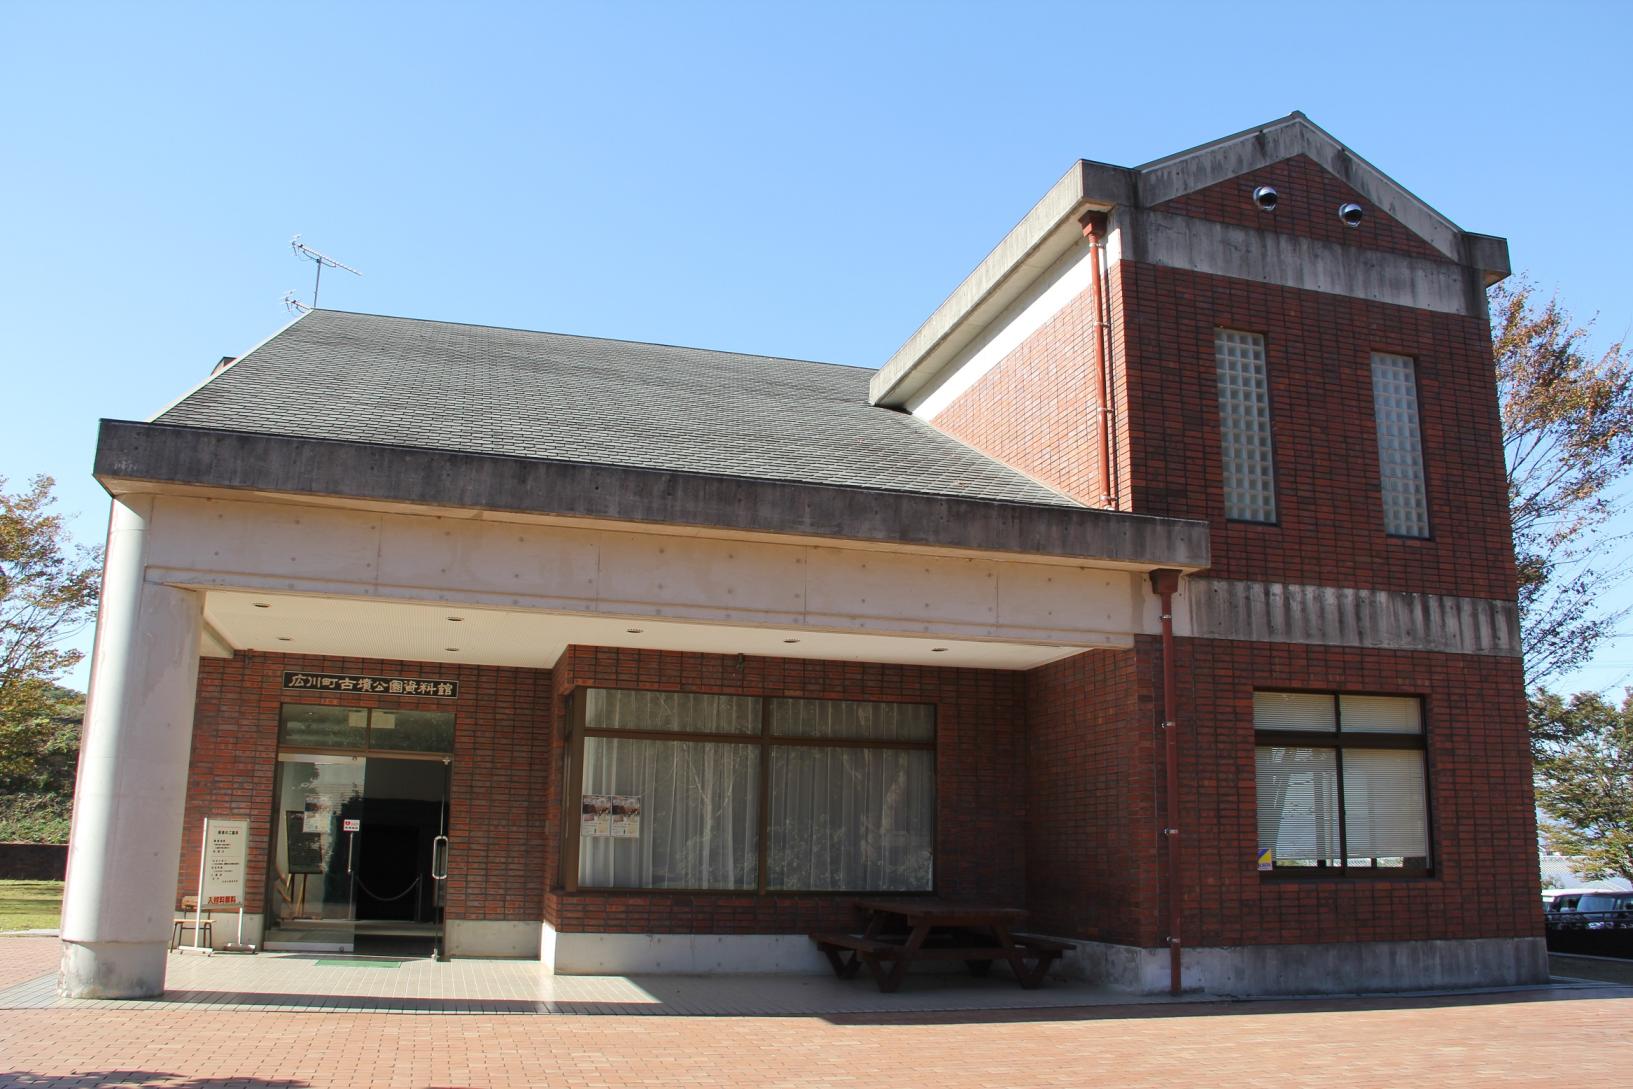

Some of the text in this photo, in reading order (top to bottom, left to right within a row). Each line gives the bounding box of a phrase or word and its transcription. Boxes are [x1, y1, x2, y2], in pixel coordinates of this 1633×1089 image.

[288, 674, 453, 695] 広川町古墳公園資料館
